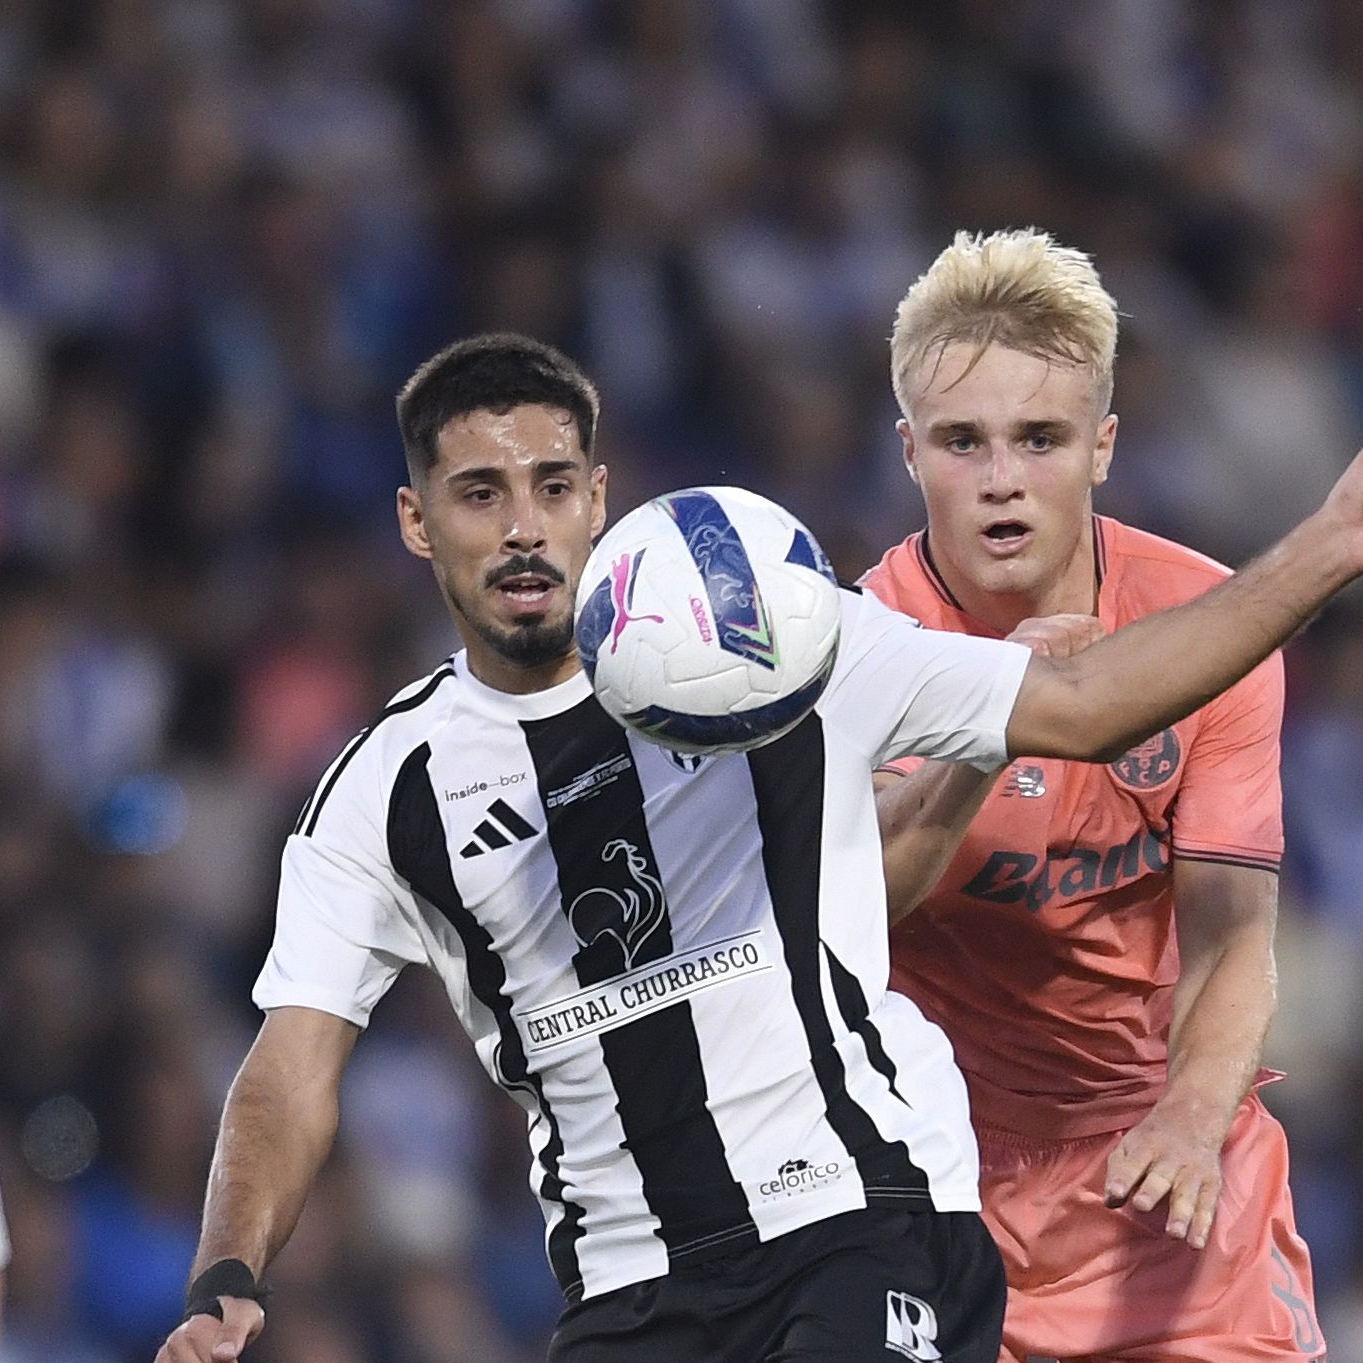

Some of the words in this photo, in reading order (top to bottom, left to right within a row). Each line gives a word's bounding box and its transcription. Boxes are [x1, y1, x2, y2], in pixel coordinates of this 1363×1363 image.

[527, 994, 618, 1044] CENTRAL
[620, 942, 759, 1010] CHURRASCO
[759, 1162, 839, 1196] celorico
